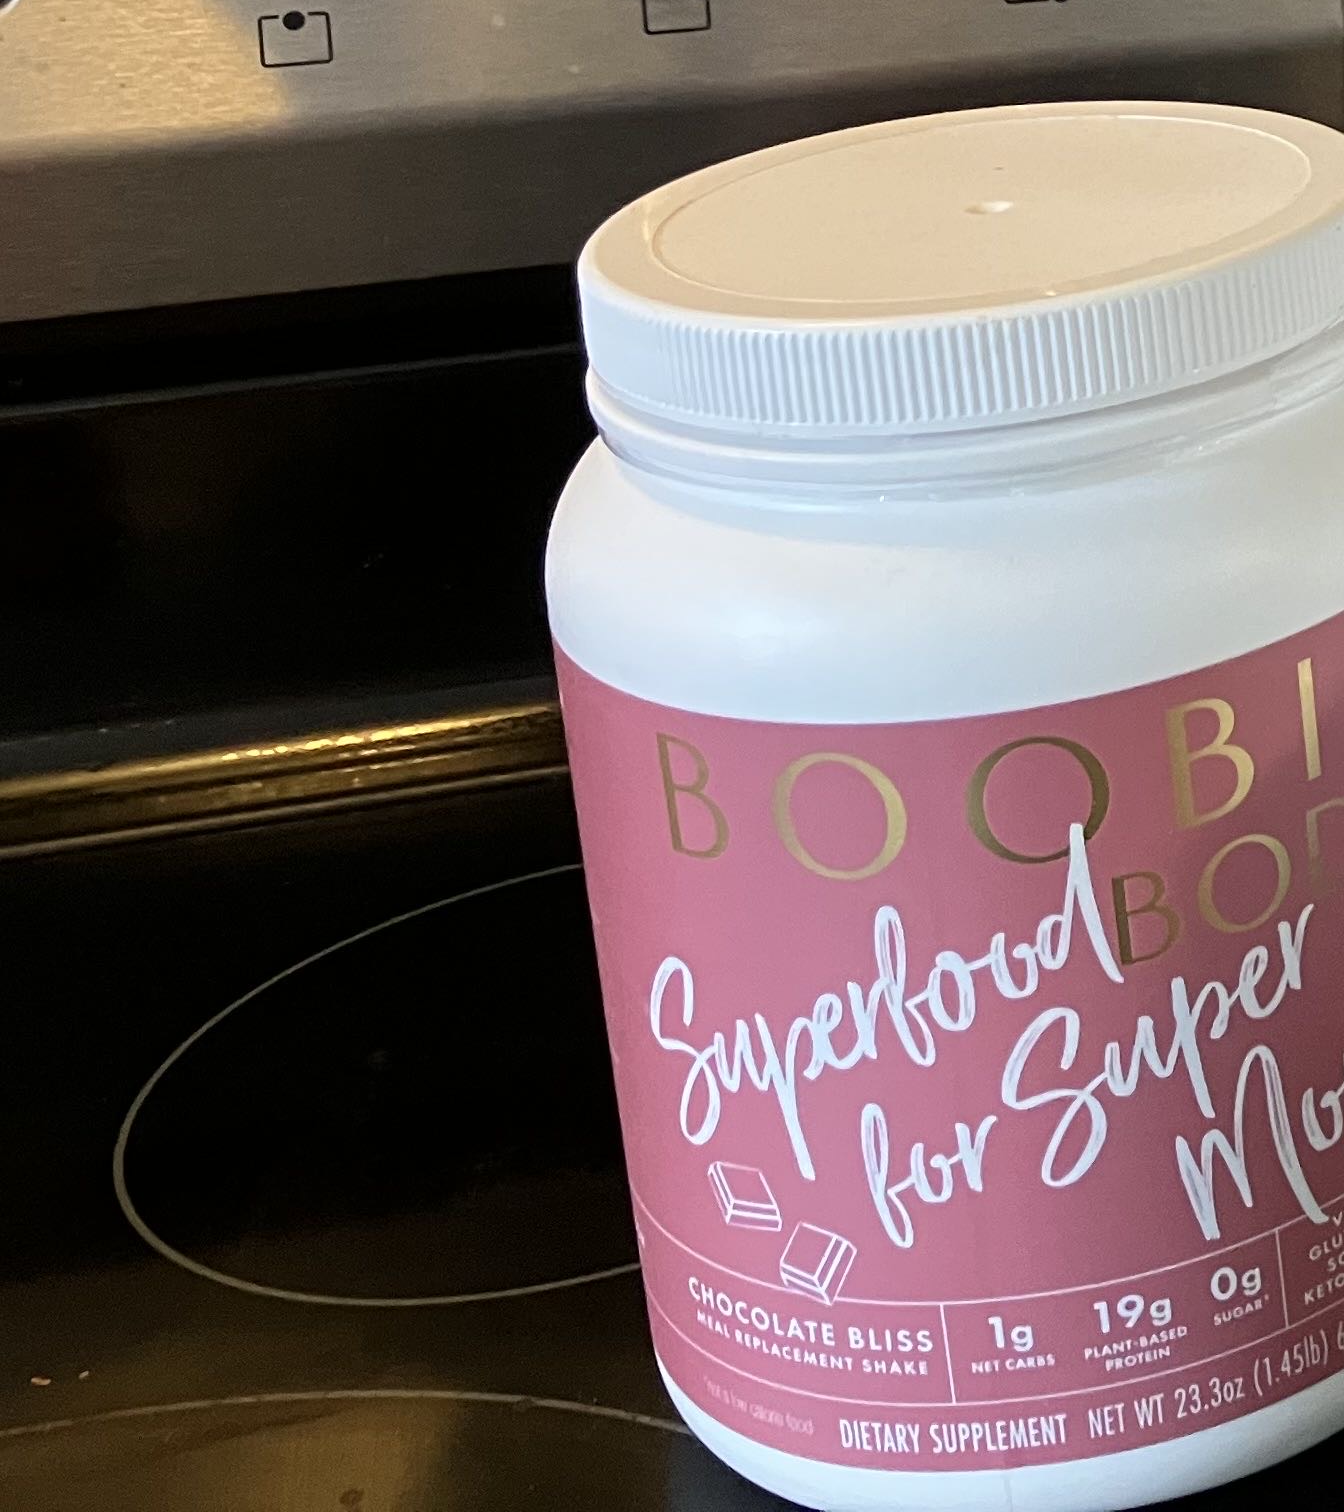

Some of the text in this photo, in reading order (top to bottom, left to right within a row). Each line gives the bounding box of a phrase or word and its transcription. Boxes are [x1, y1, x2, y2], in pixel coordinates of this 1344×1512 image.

[650, 822, 1124, 1181] Superfood
[861, 902, 1315, 1248] for Super
[1210, 1266, 1262, 1301] 0g
[688, 1276, 934, 1352] CHOCOLATE BLISS
[988, 1316, 1034, 1352] 1g
[1093, 1294, 1172, 1334] 19g
[697, 1309, 928, 1375] MEAL REPLACEMENT SHAKE
[1084, 1326, 1188, 1359] PLANT-BASED
[1105, 1346, 1171, 1372] PROTEIN
[971, 1353, 1056, 1374] NET CARBS
[839, 1419, 920, 1454] DIETARY
[929, 1413, 1067, 1454] SUPPLEMENT
[1087, 1403, 1125, 1439] NET
[1134, 1394, 1165, 1429] WT
[1174, 1376, 1245, 1419] 23.3oz
[1252, 1328, 1330, 1396] (1.45lb)
